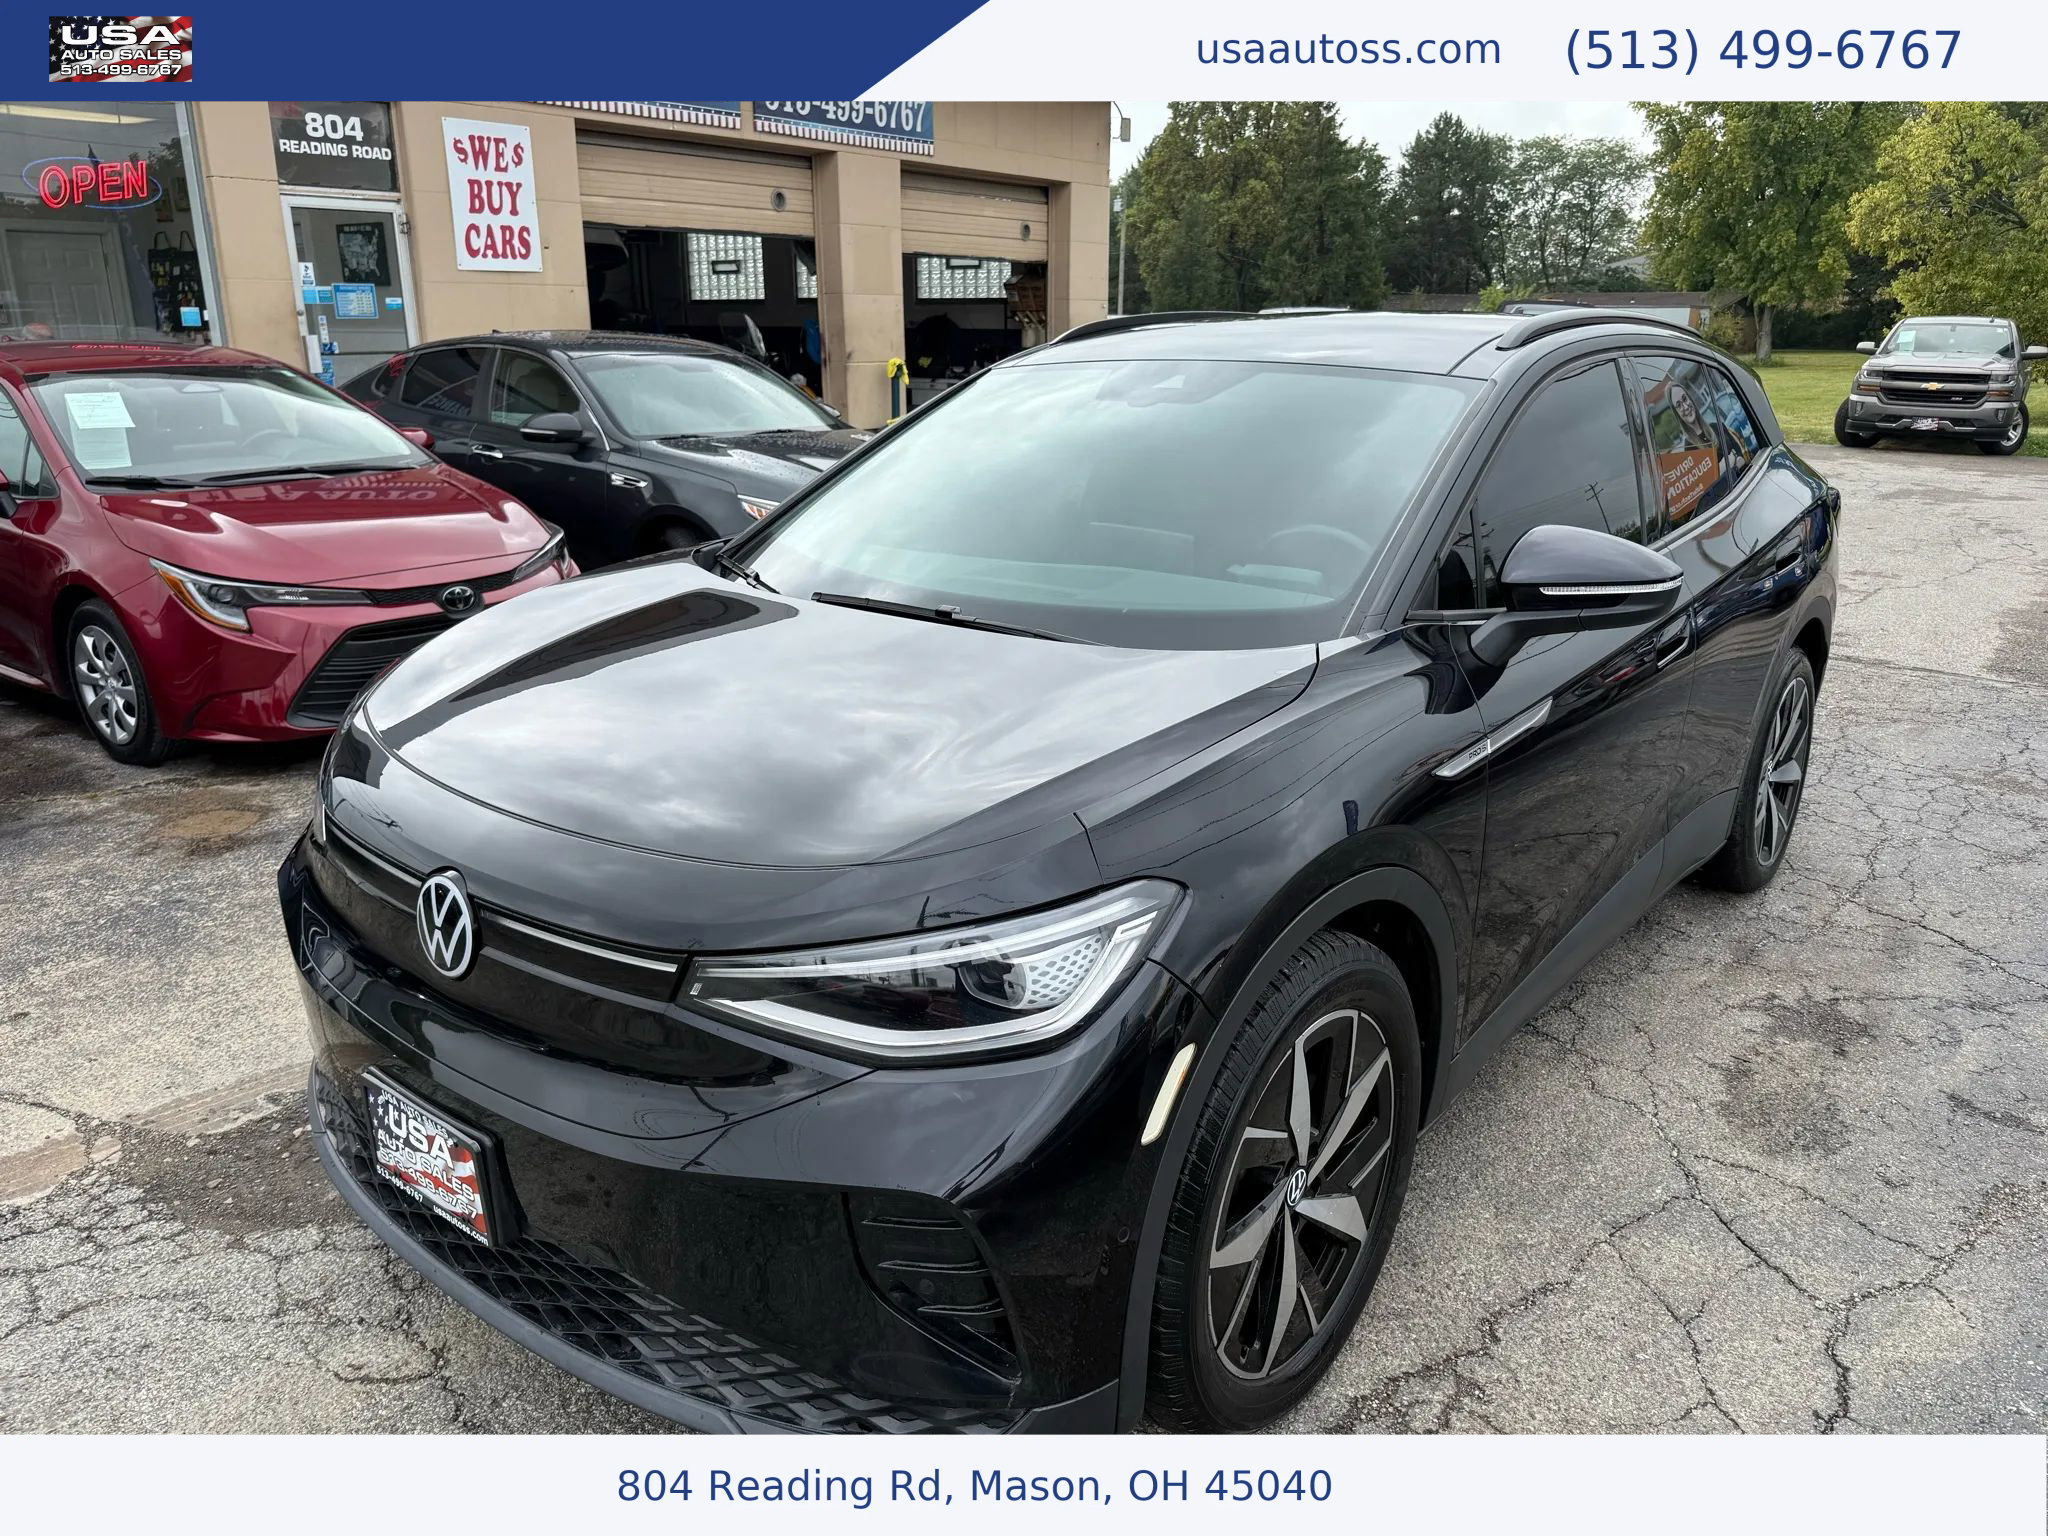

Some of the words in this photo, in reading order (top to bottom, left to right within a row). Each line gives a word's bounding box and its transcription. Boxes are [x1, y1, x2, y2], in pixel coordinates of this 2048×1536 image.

[304, 112, 364, 142] 804
[279, 139, 348, 157] READING
[352, 145, 392, 160] ROAD
[39, 160, 148, 209] OPEN
[467, 178, 522, 217] BUY
[465, 223, 531, 260] CARS
[382, 1090, 399, 1107] USA
[400, 1102, 421, 1122] AUTO
[388, 1104, 454, 1171] USA
[377, 1129, 417, 1165] AUTO
[421, 1157, 475, 1201] SALES
[379, 1147, 478, 1219] 513-499-6767
[433, 1204, 489, 1247] usaautoss.com
